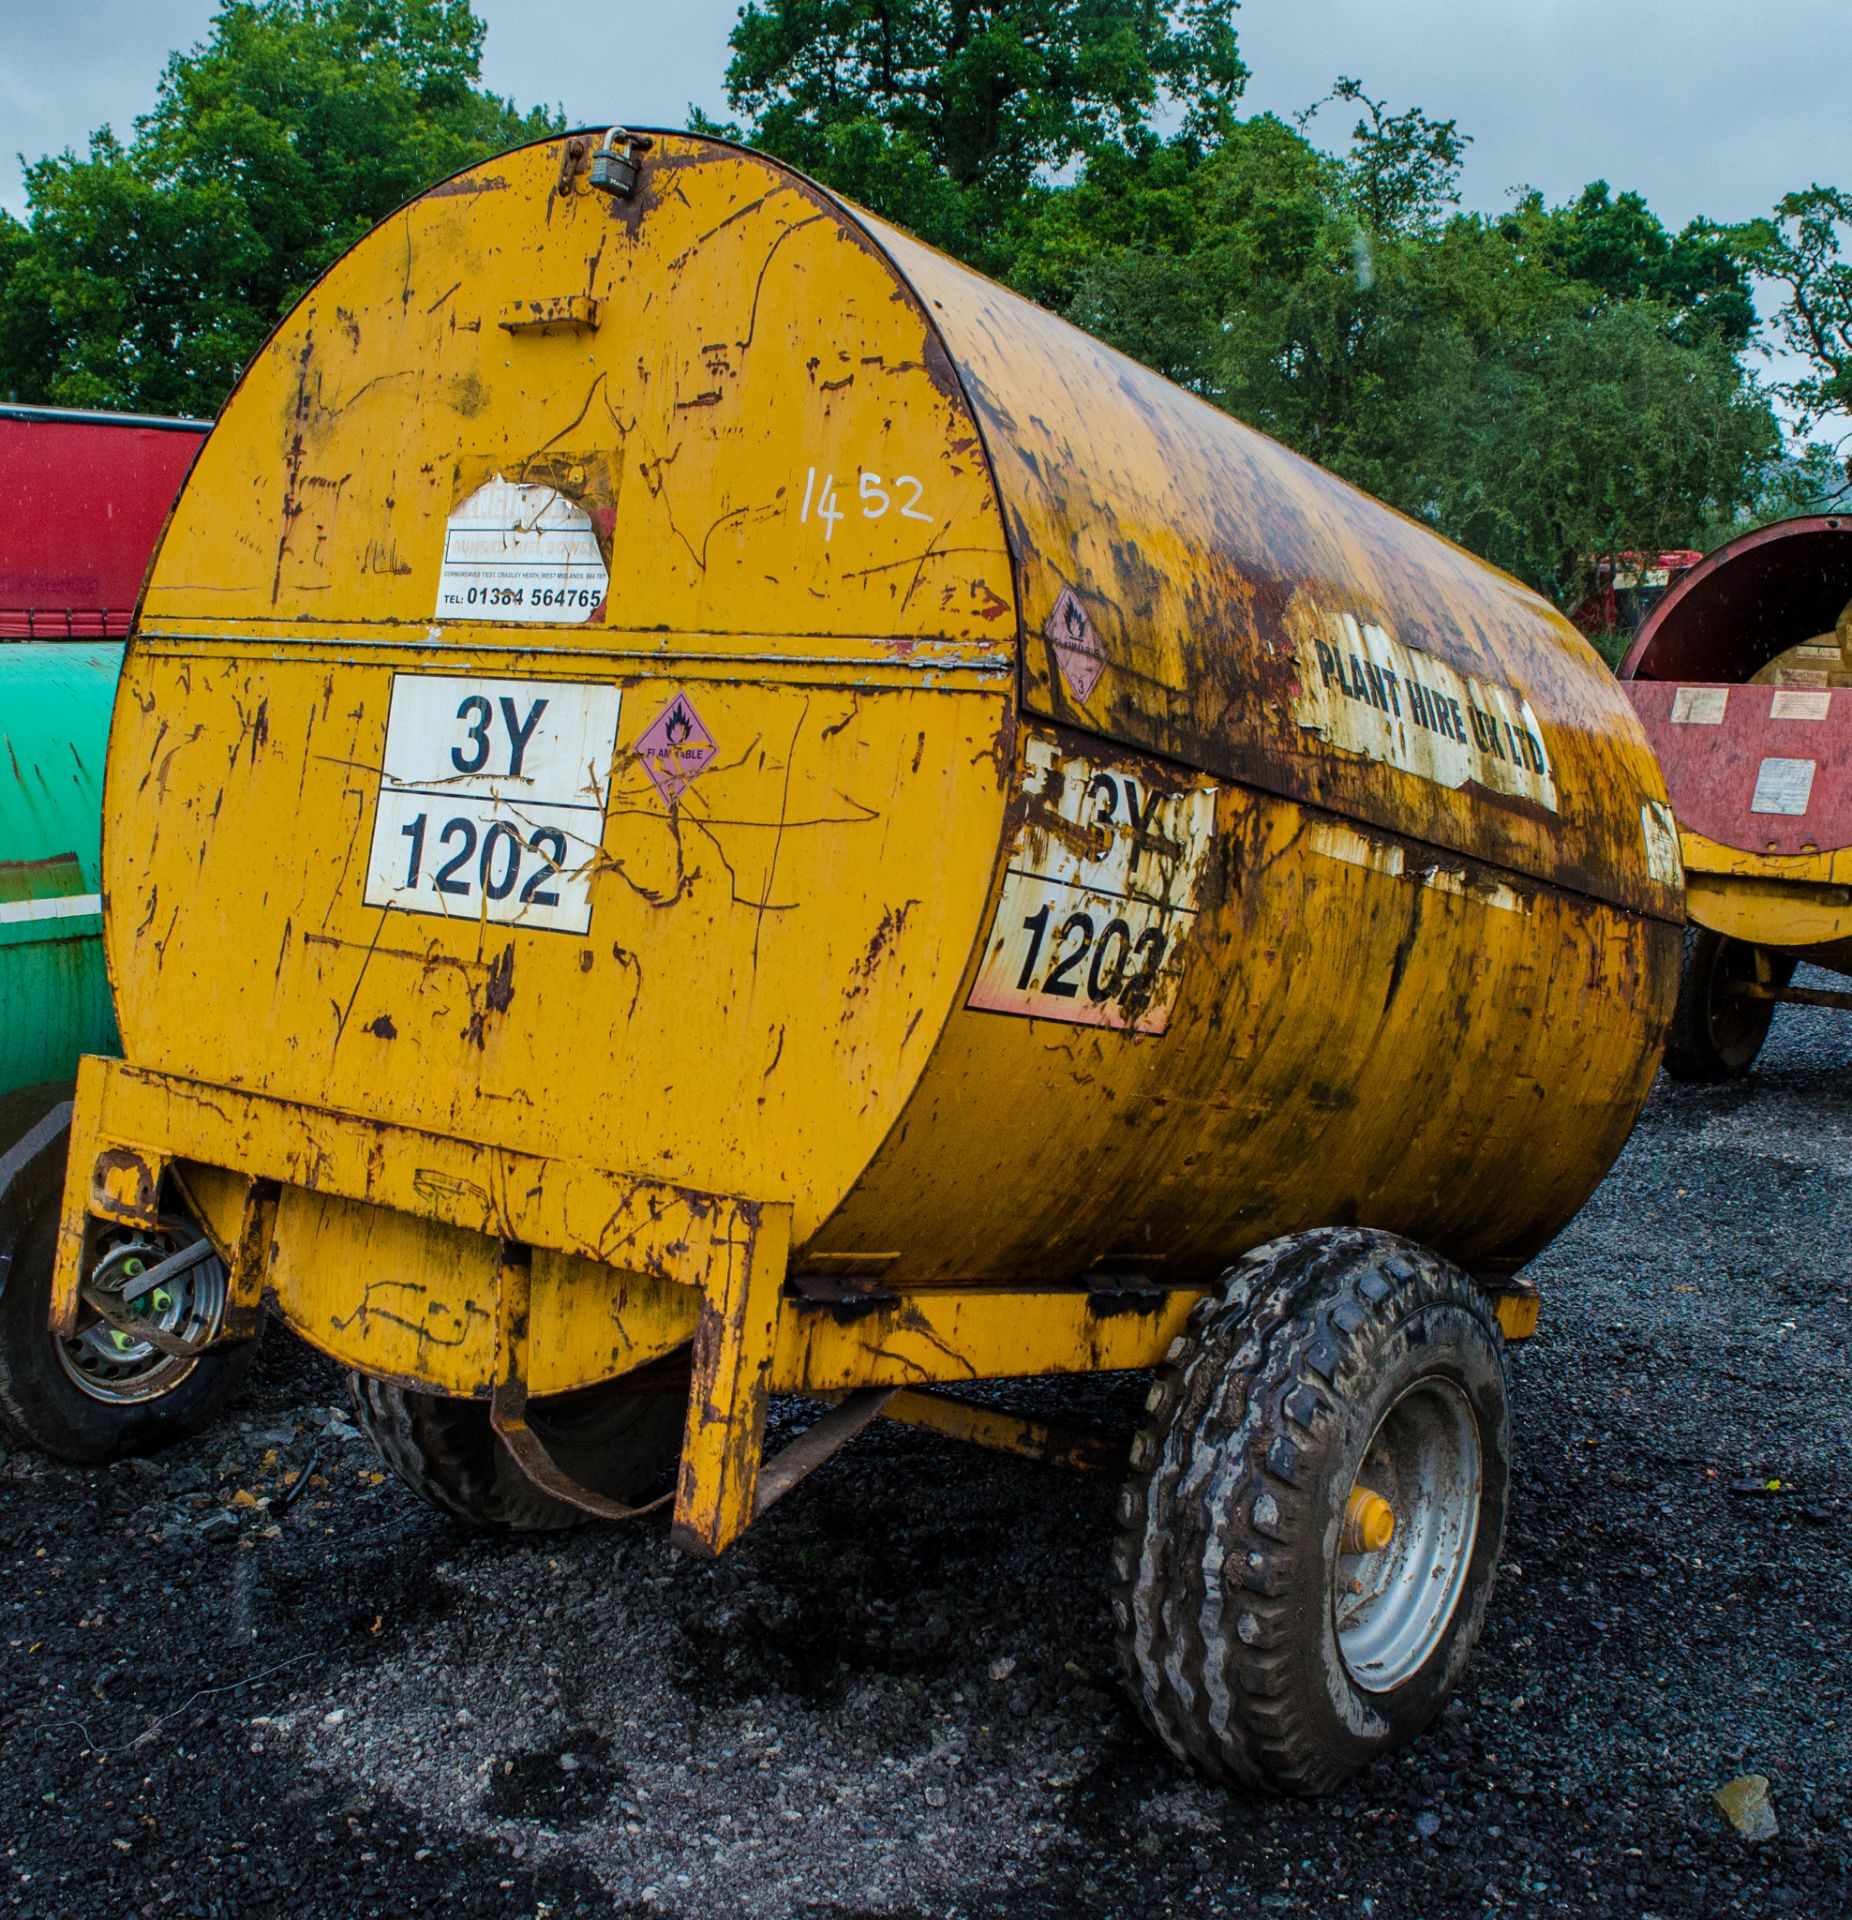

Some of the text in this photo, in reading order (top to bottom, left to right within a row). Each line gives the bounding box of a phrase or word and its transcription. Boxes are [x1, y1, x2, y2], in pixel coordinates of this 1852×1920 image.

[444, 587, 602, 608] TEL: 01384 564765
[1077, 679, 1085, 695] 3
[1313, 637, 1401, 719] PLANT
[1404, 677, 1468, 745] HIRE
[1504, 721, 1545, 776] LTD
[451, 695, 550, 776] 3Y
[401, 813, 567, 907] 1202
[1087, 772, 1165, 873] 3Y
[1016, 903, 1167, 1008] 1202
